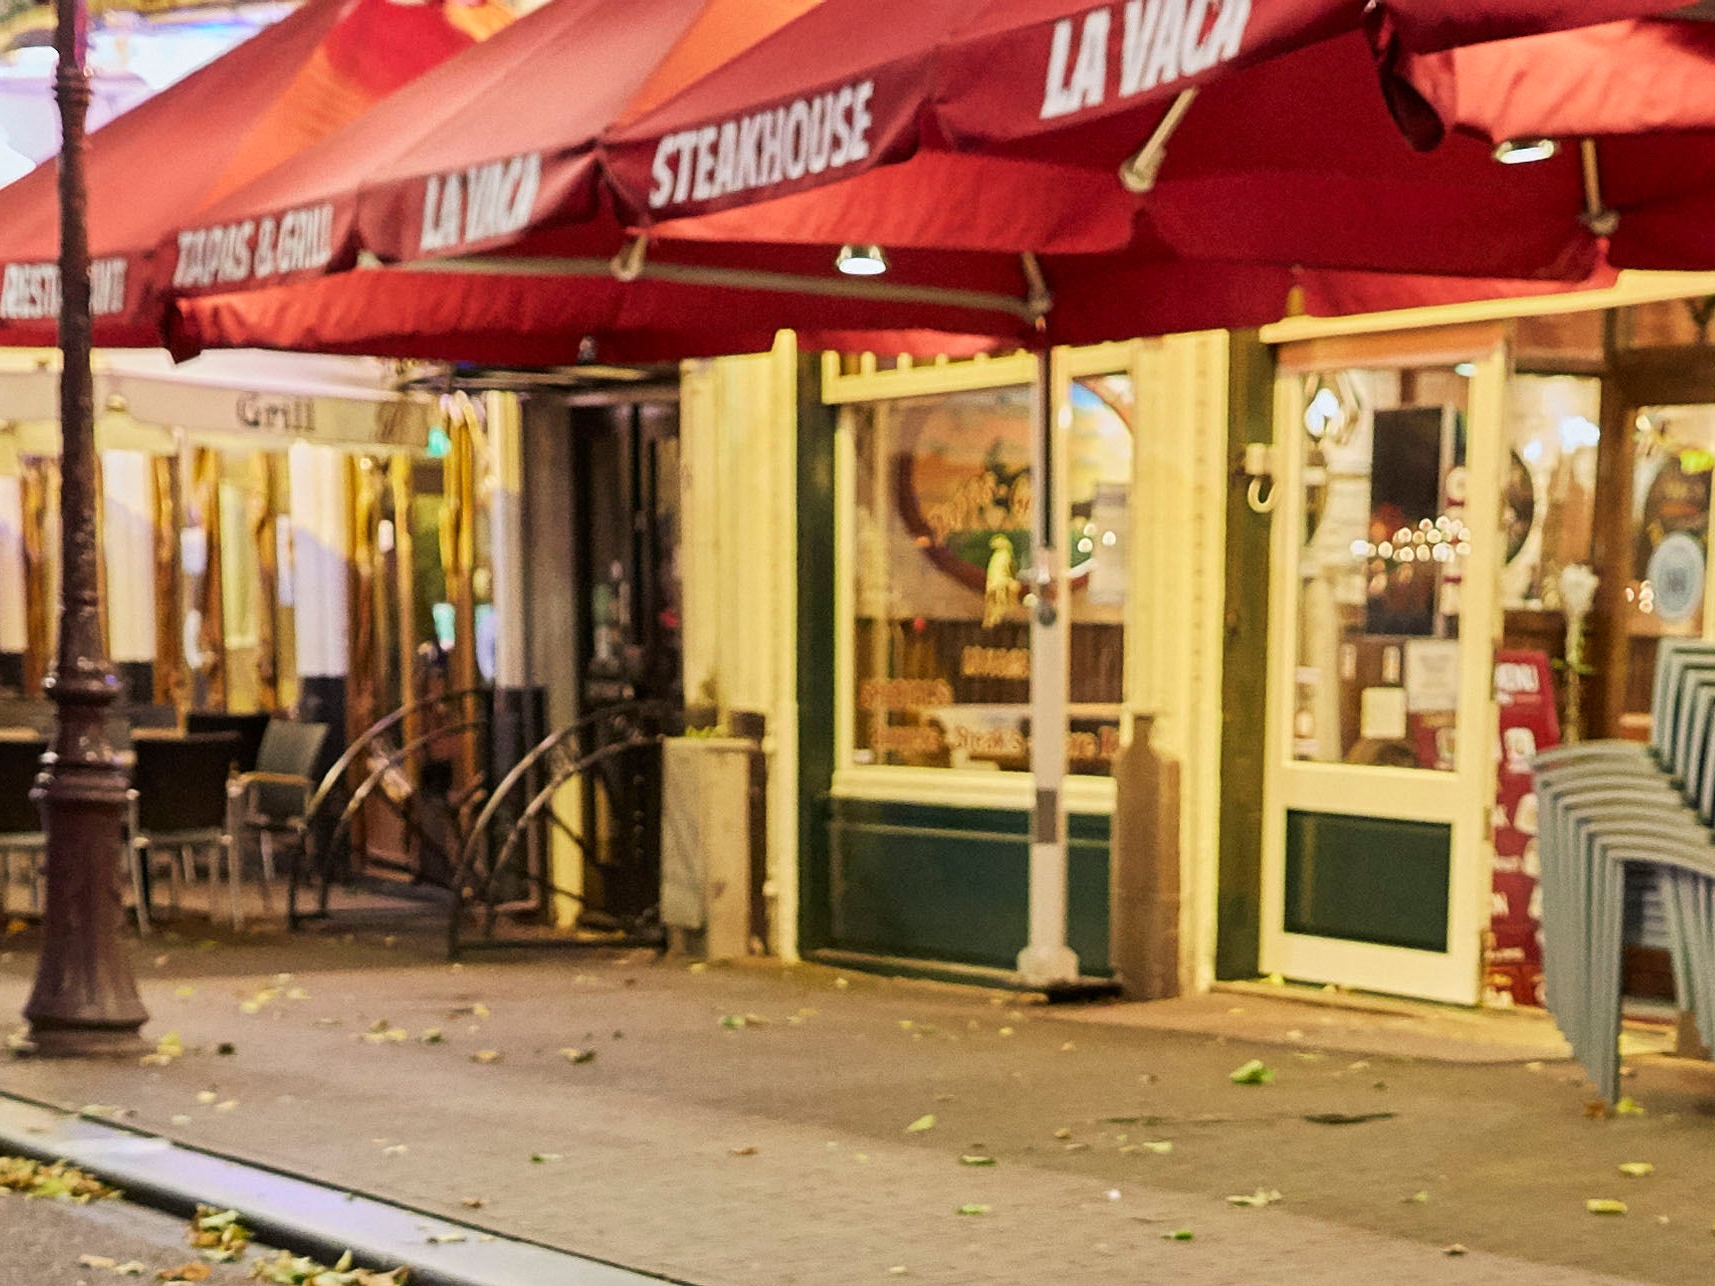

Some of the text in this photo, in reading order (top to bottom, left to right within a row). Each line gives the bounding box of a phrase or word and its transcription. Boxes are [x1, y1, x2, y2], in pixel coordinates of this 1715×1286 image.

[1039, 0, 1253, 120] LA VACA
[648, 80, 876, 210] STEAKHOUSE
[172, 202, 335, 289] TAPAS & GRILL
[420, 152, 542, 250] LA VACA
[236, 393, 316, 432] Grill
